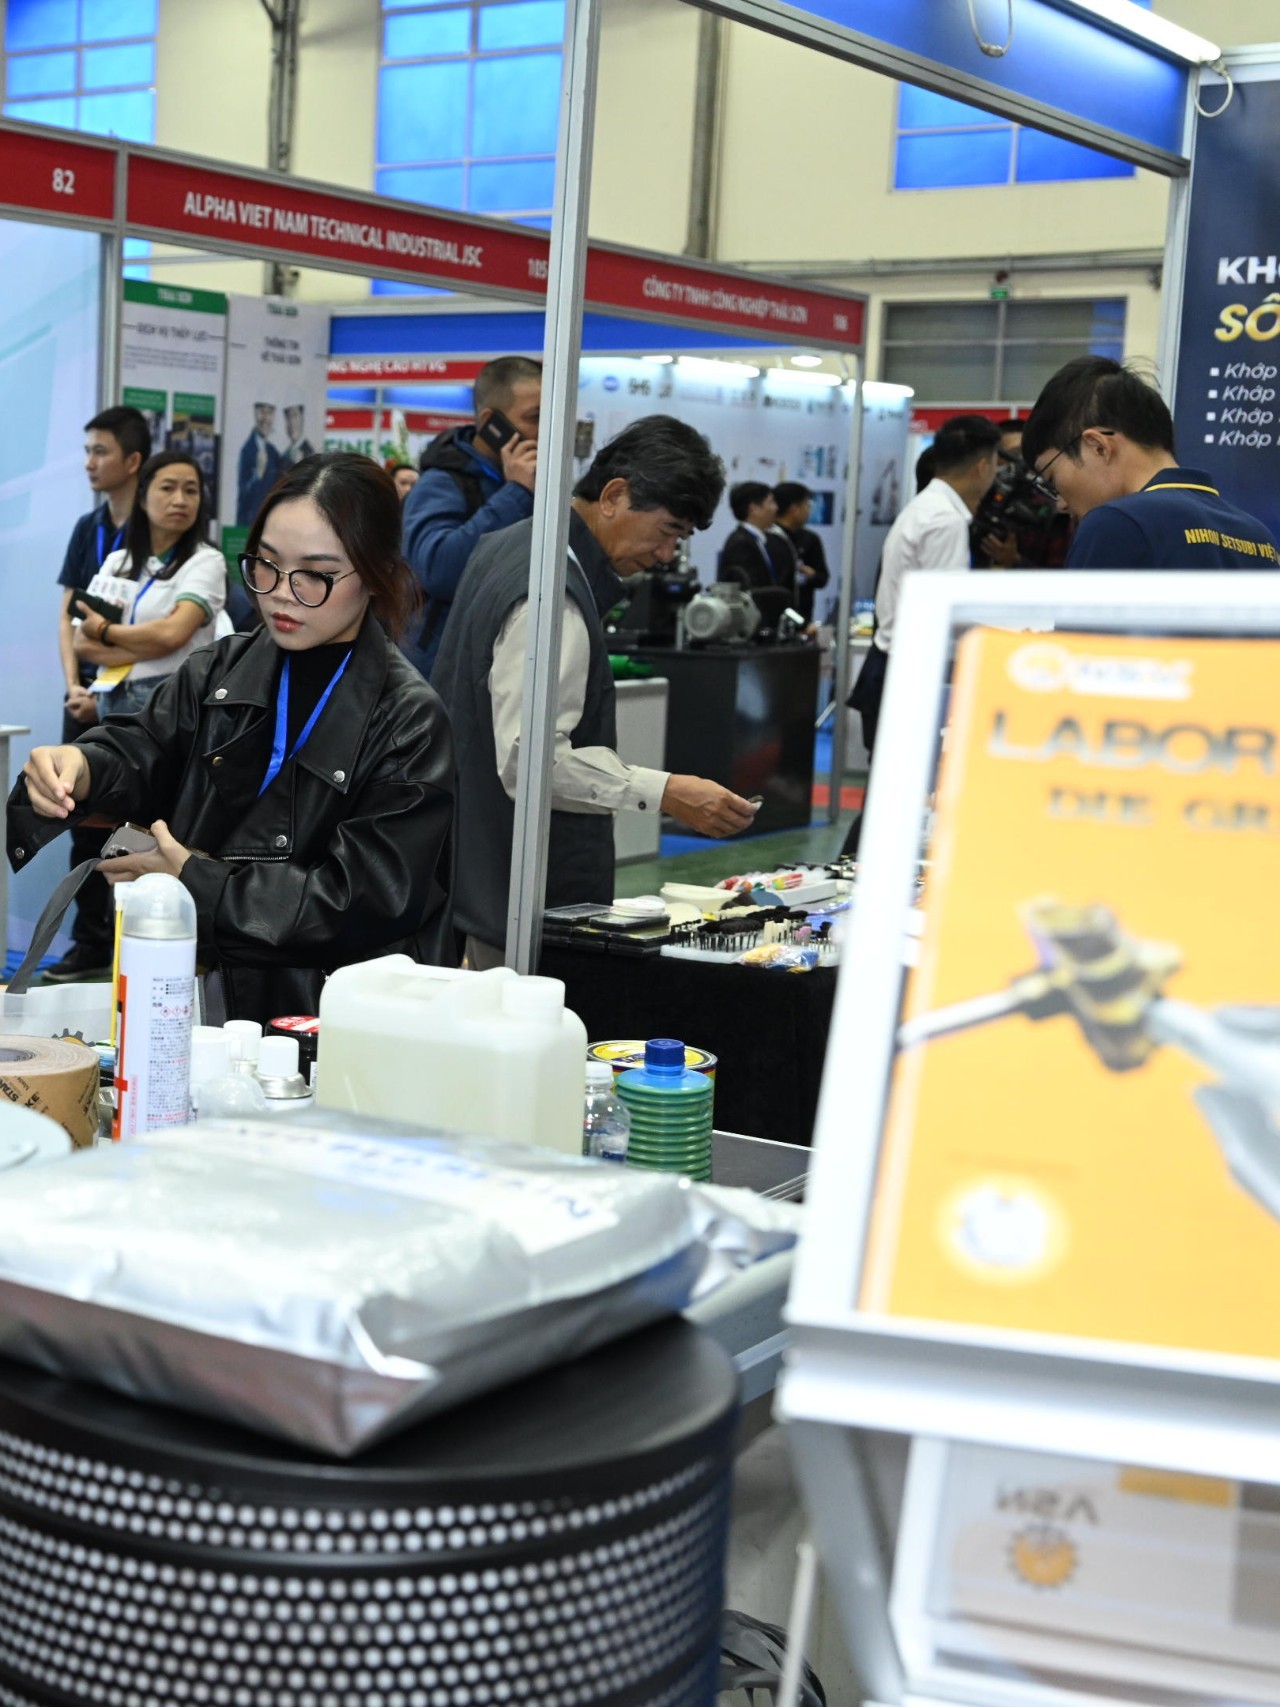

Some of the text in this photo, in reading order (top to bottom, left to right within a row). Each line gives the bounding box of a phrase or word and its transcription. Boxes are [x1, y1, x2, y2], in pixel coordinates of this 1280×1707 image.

[52, 167, 76, 195] 82
[183, 191, 483, 268] ALPHA VIET NAM TECHNICAL INDUSTRIAL JSC
[1217, 255, 1280, 286] KH
[1184, 528, 1220, 546] NIHON
[1220, 533, 1258, 557] SETSUBI
